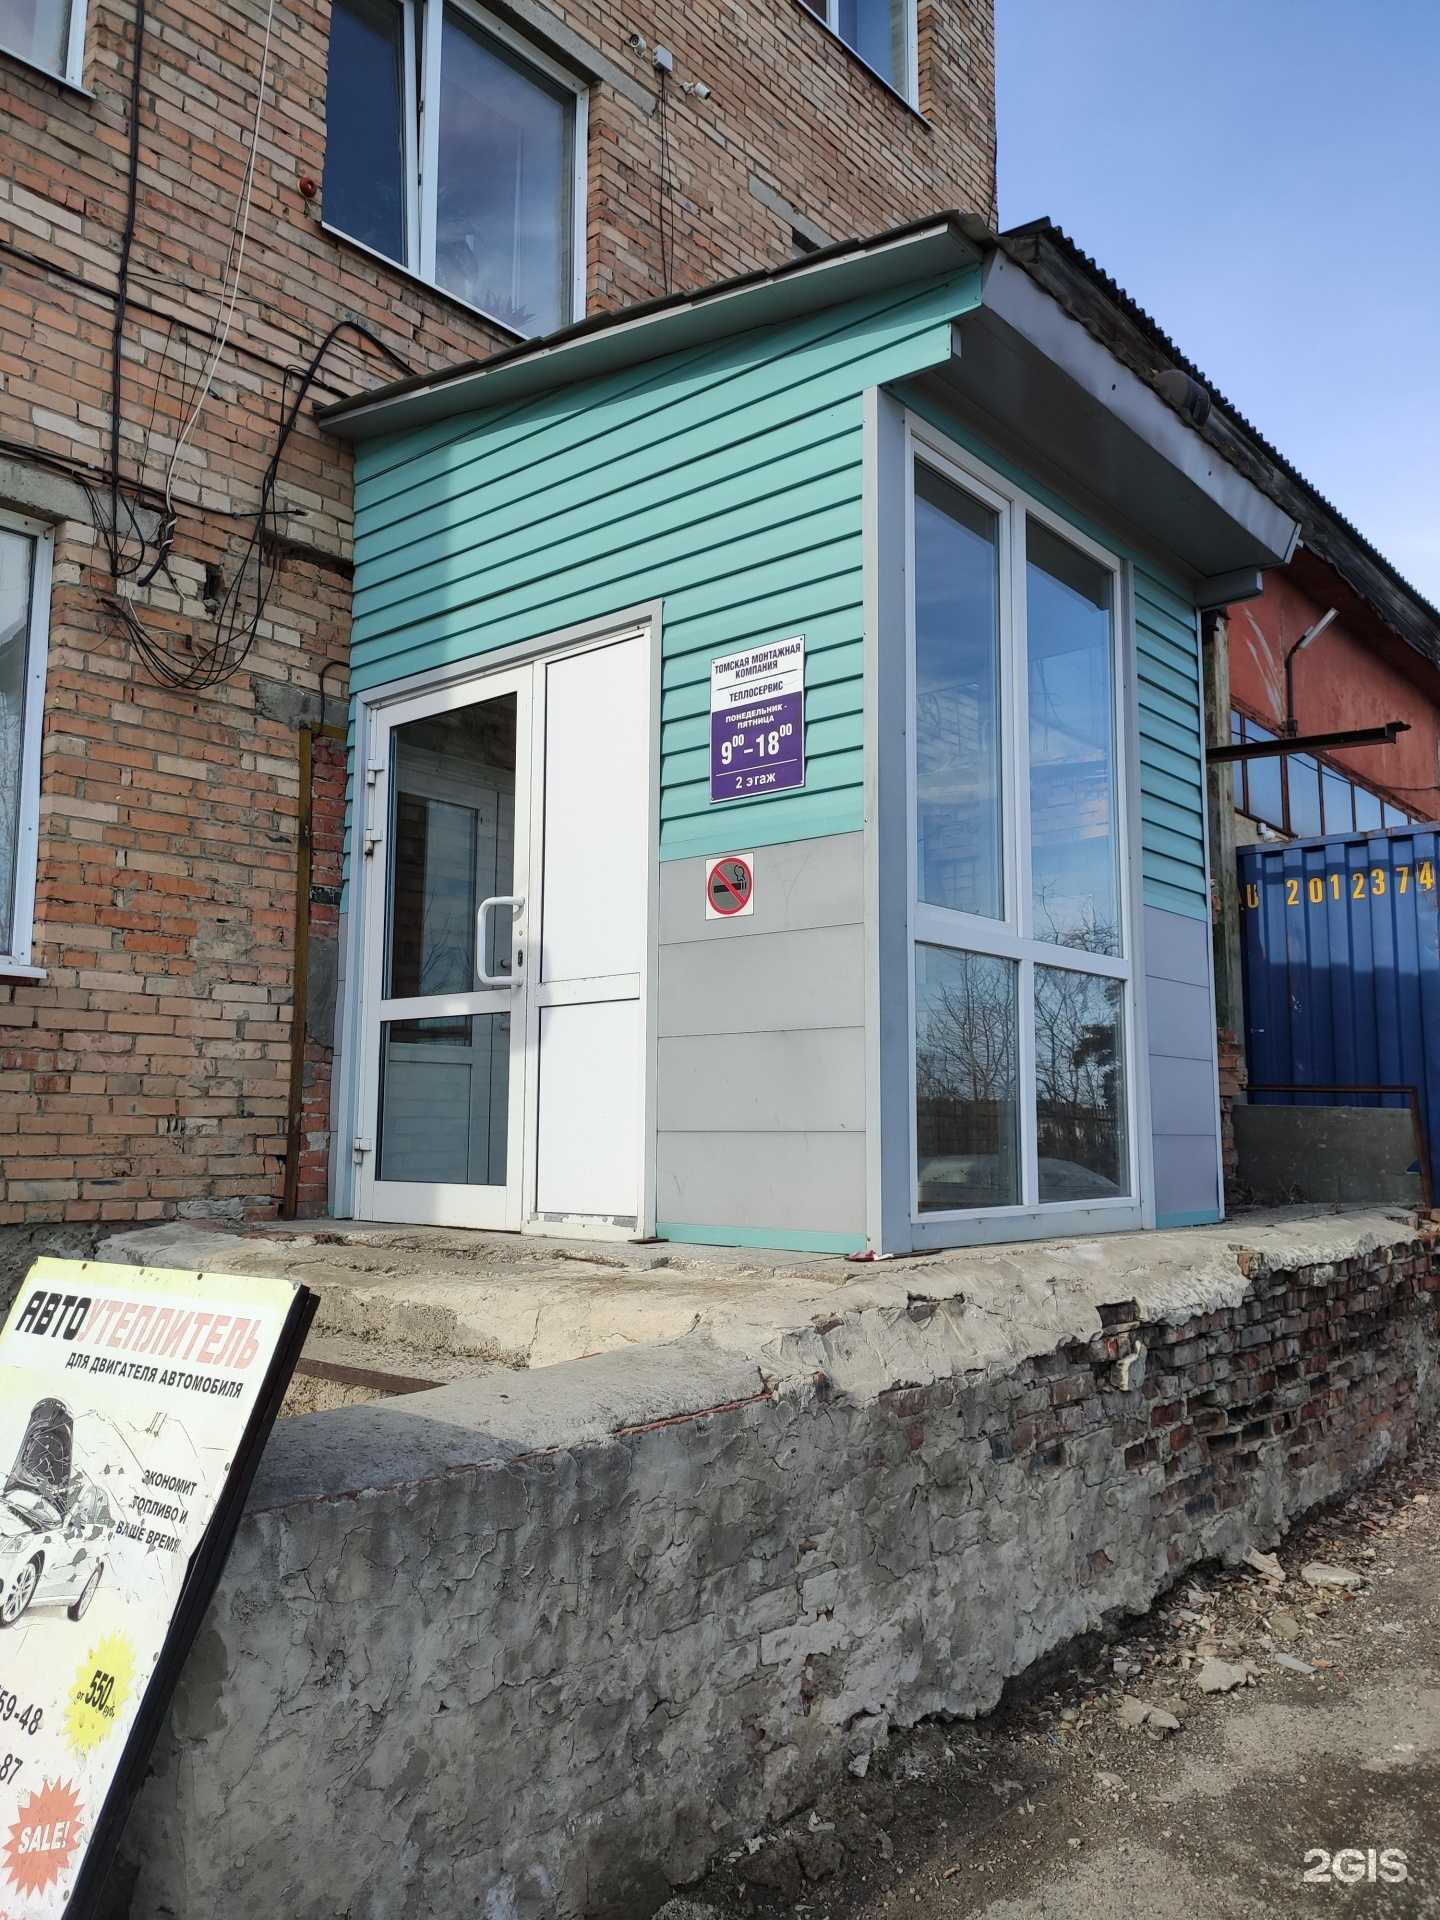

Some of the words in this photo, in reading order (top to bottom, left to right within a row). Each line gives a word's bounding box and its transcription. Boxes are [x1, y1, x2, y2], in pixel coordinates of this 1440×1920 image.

[715, 657, 749, 674] ТОМСКАЯ
[752, 643, 801, 664] МОНТАЖНАЯ
[736, 660, 778, 679] КОМПАНИЯ
[729, 681, 783, 702] ТЕПЛОСЕРВИС
[725, 703, 783, 723] ПОНЕДЕЛЬНИК
[737, 715, 775, 730] ПЯТНИЦА
[736, 776, 742, 789] 2
[746, 773, 776, 787] этаж
[14, 1290, 263, 1370] АВТОУТЕПЛИТЕЛЬ
[65, 1352, 90, 1370] ДЛЯ
[89, 1356, 158, 1384] ДВИГАТЕЛЯ
[159, 1369, 244, 1399] АВТОМОБИЛЯ
[142, 1469, 197, 1496] ЭКОНОМИТ
[132, 1495, 179, 1521] ТОПЛИВО
[179, 1510, 189, 1524] И
[116, 1520, 146, 1541] ВАШЕ
[85, 1670, 114, 1711] 550
[0, 1686, 43, 1735] 59-48
[0, 1753, 23, 1785] 87
[18, 1820, 70, 1854] SALE!
